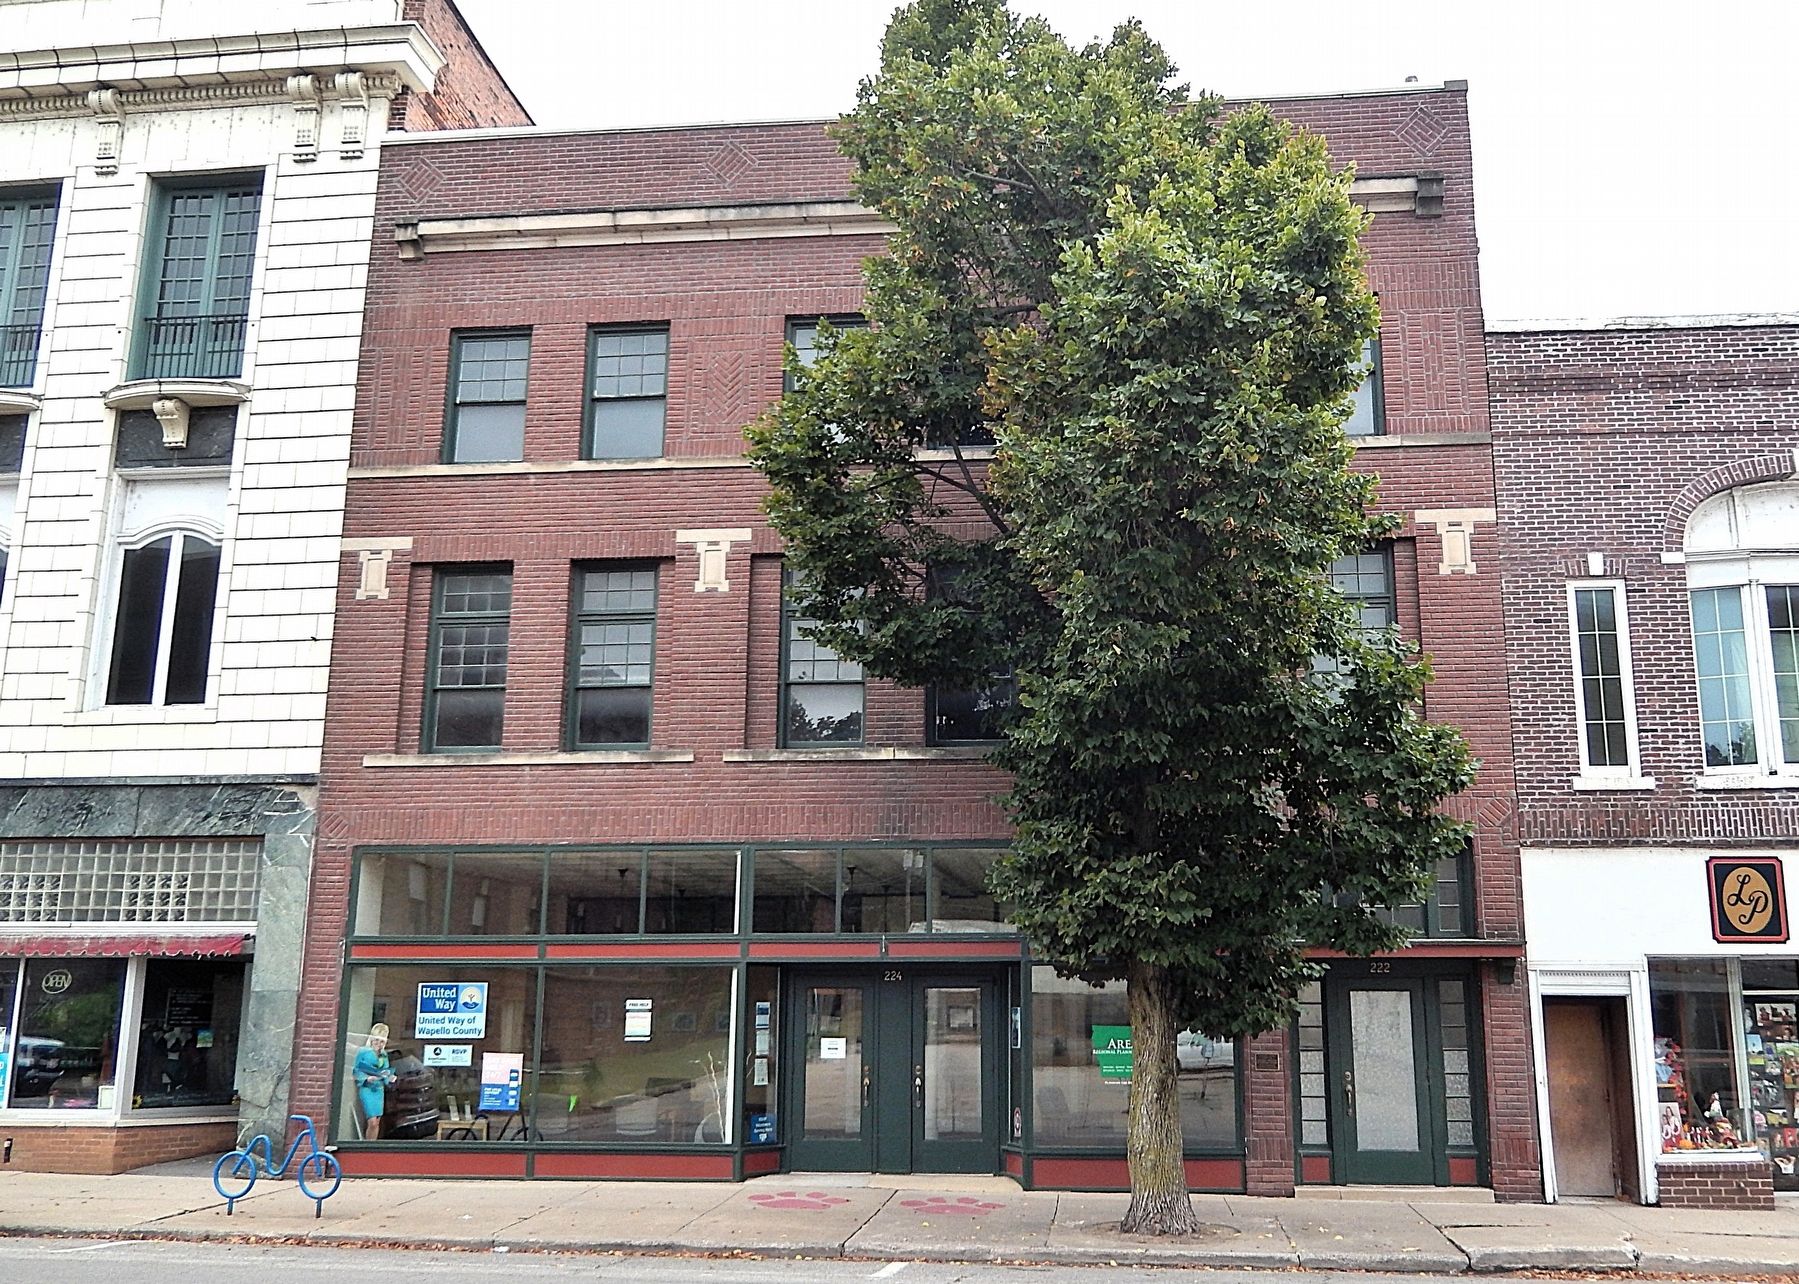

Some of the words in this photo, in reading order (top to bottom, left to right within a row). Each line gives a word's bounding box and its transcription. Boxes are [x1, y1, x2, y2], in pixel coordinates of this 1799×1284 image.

[1370, 962, 1390, 973] 222
[884, 970, 902, 981] 224
[422, 987, 457, 999] United
[435, 999, 457, 1012] Way
[418, 1016, 446, 1025] United
[447, 1016, 466, 1026] Way
[467, 1016, 476, 1025] of
[418, 1027, 451, 1037] Wapello
[453, 1027, 483, 1037] County
[1107, 1038, 1133, 1049] ARE
